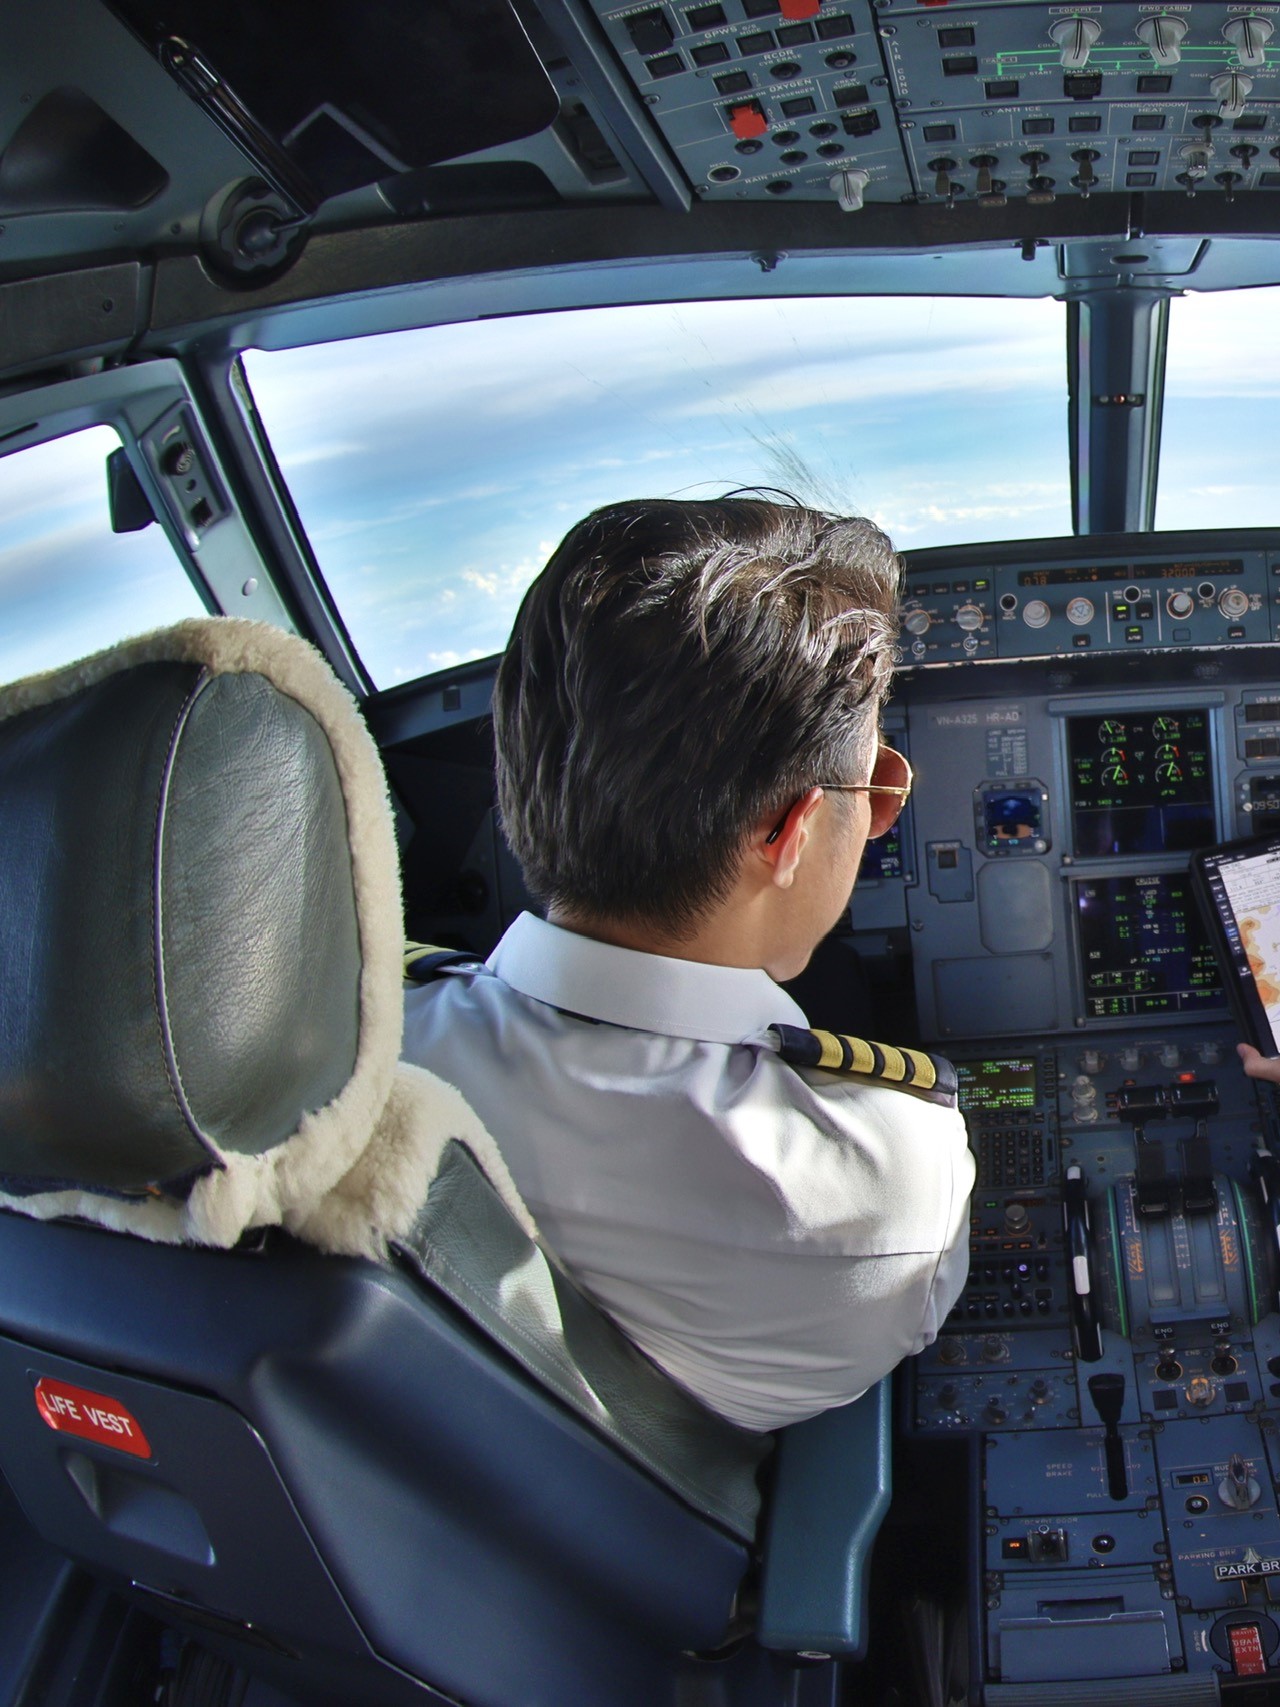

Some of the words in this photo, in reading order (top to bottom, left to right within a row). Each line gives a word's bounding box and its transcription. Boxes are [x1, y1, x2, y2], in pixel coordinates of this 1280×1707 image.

[704, 26, 738, 39] GPWS
[739, 27, 762, 36] MODE
[763, 49, 795, 61] RCDR
[769, 79, 813, 93] OXYGEN
[770, 87, 816, 100] PASSENGER
[997, 106, 1022, 114] ANTI
[825, 156, 859, 167] WIPER
[745, 173, 769, 183] RAIN
[1161, 568, 1196, 578] 32000
[936, 713, 978, 725] VN-A325
[985, 711, 1020, 722] HR-AD
[1135, 877, 1161, 886] CRUISE
[40, 1391, 82, 1421] LIFE
[82, 1405, 133, 1437] VEST
[1178, 1551, 1216, 1560] PARKING
[1218, 1564, 1257, 1576] PARK
[1235, 1645, 1260, 1653] EXTN
